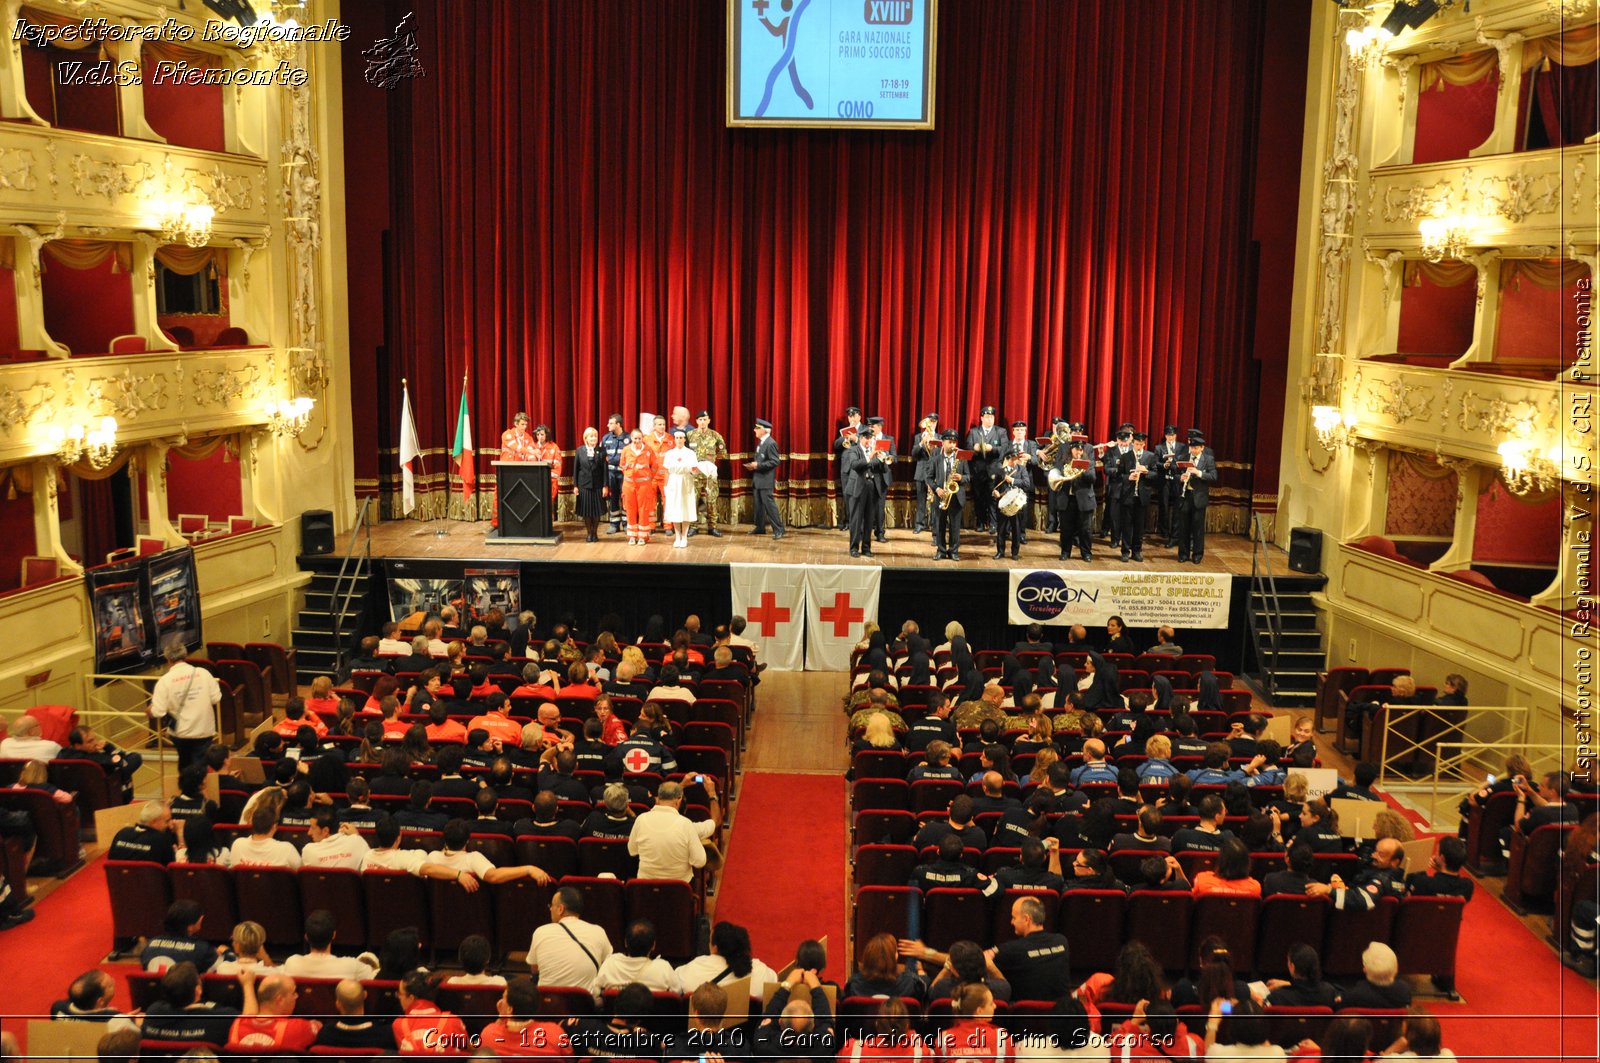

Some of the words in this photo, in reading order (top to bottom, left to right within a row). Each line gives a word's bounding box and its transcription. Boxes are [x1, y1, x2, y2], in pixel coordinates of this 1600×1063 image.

[839, 31, 861, 44] GARA
[865, 32, 911, 44] NAZIONALE
[839, 46, 866, 58] PRIMO
[869, 47, 911, 59] SOCCORSO
[880, 91, 909, 99] SETTEMBRE
[837, 101, 873, 118] COMO
[1121, 573, 1215, 586] ALLESTIMENTO
[1017, 586, 1100, 604] ORION
[1110, 585, 1162, 597] VEICOLI
[1166, 587, 1224, 599] SPECIALI
